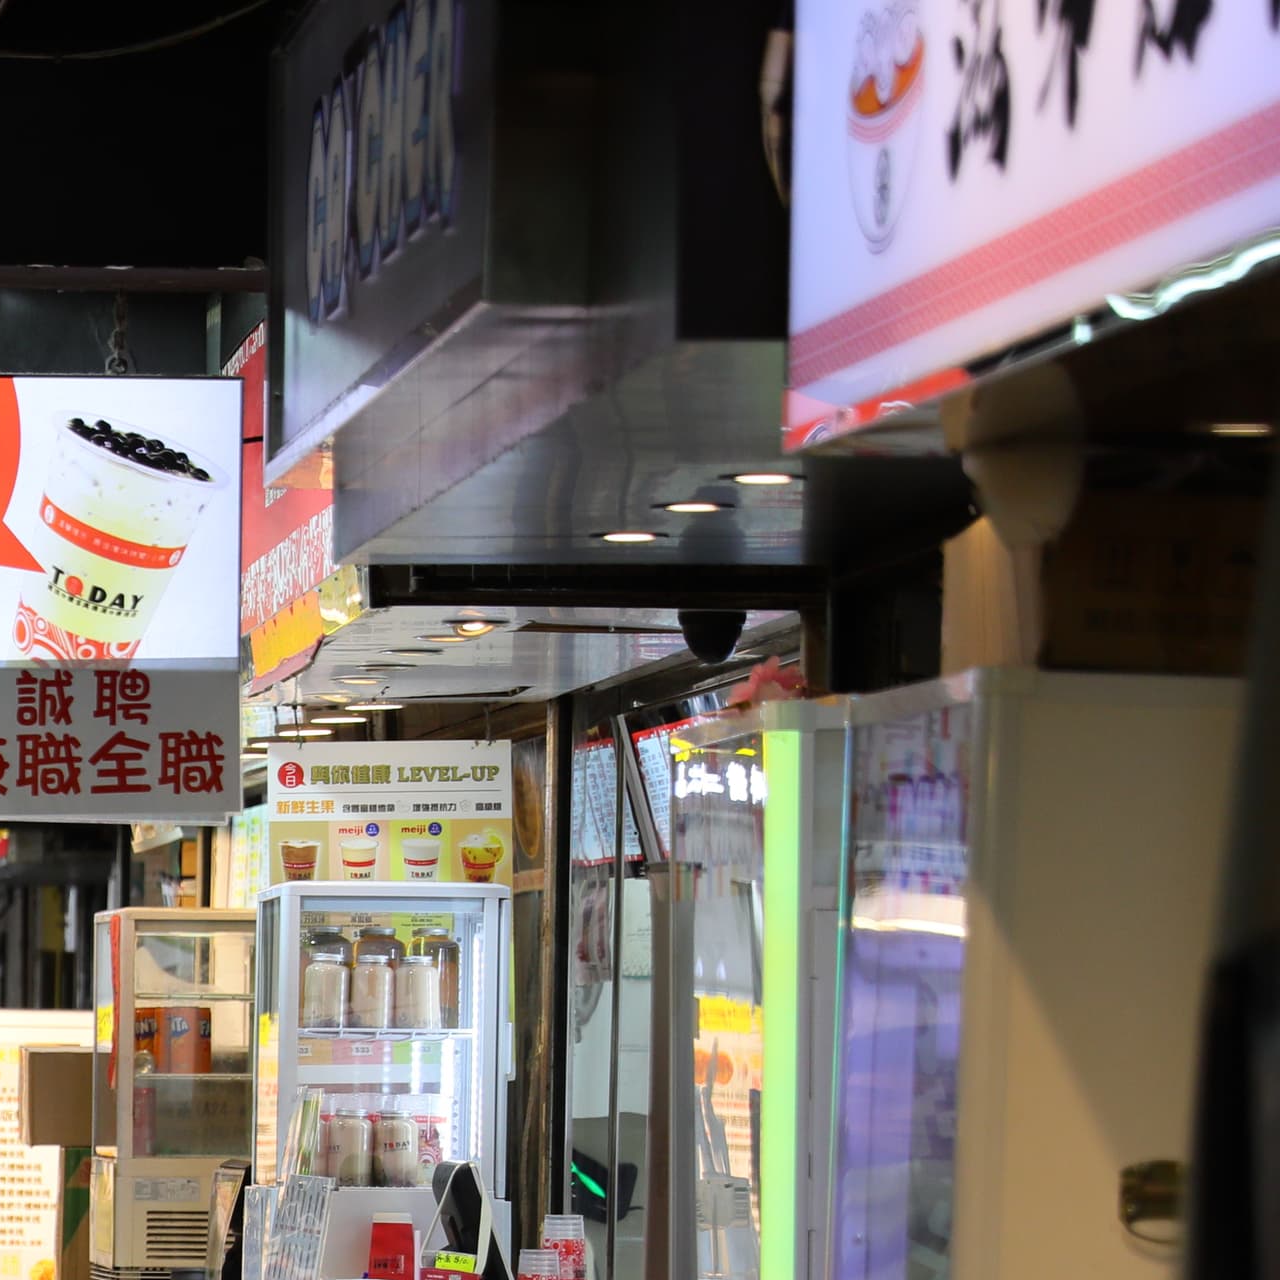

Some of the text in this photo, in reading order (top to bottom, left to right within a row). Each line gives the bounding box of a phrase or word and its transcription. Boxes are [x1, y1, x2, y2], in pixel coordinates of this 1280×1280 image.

[15, 668, 152, 727] 誠聘
[397, 764, 500, 783] LEVEL-UP
[276, 799, 336, 814] 新鮮生果
[338, 825, 364, 836] meiji
[400, 824, 427, 835] meiji
